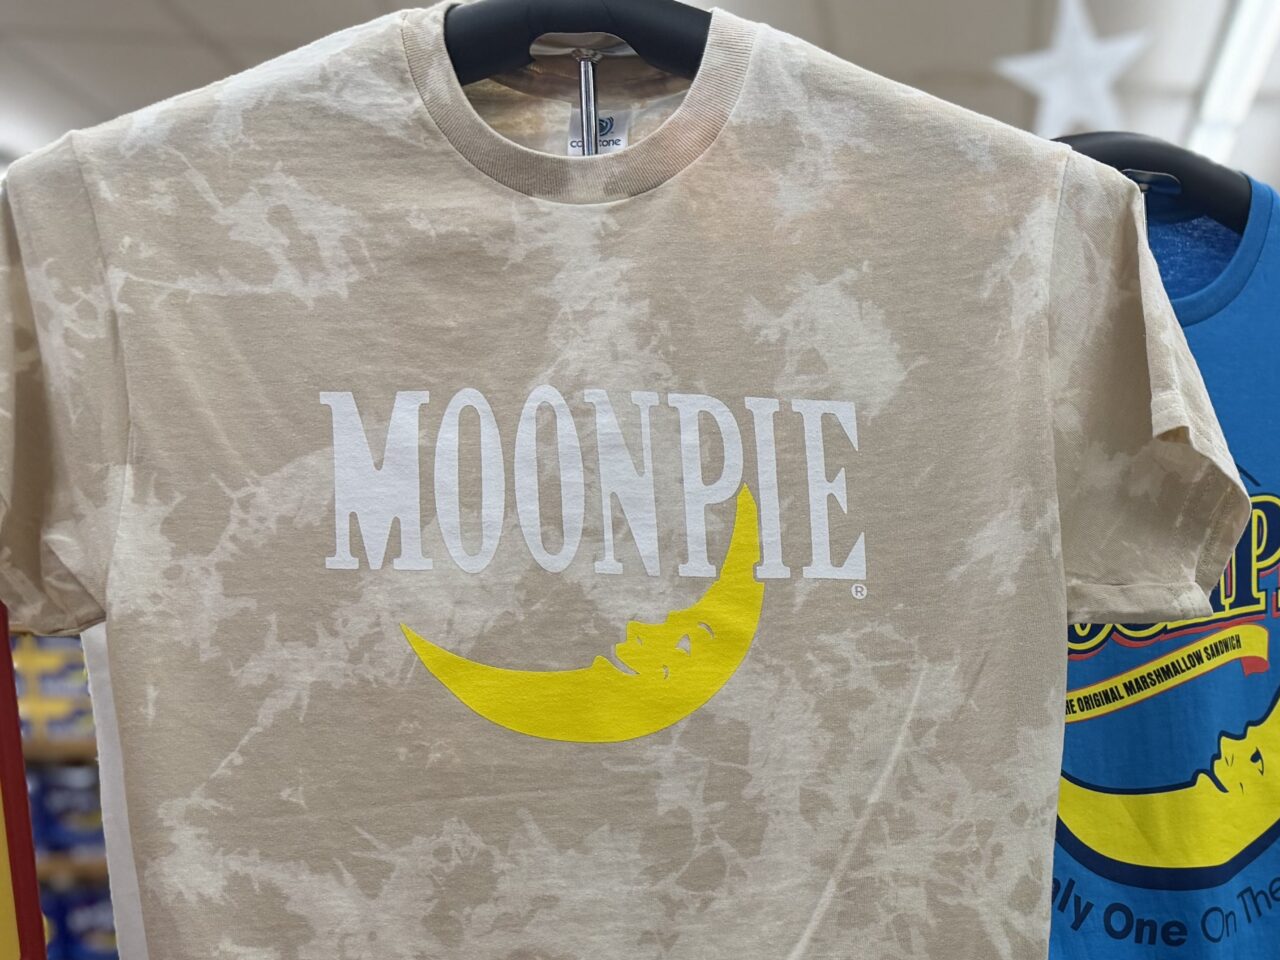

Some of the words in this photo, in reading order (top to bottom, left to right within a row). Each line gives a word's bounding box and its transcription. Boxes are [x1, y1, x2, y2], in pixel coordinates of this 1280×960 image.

[319, 384, 867, 580] MOONPIE
[1079, 685, 1125, 713] ORIGINAL
[1122, 649, 1204, 697] MARSHMALLOW
[1205, 634, 1242, 661] SANDWICH
[1103, 902, 1188, 946] One
[1201, 906, 1237, 943] On
